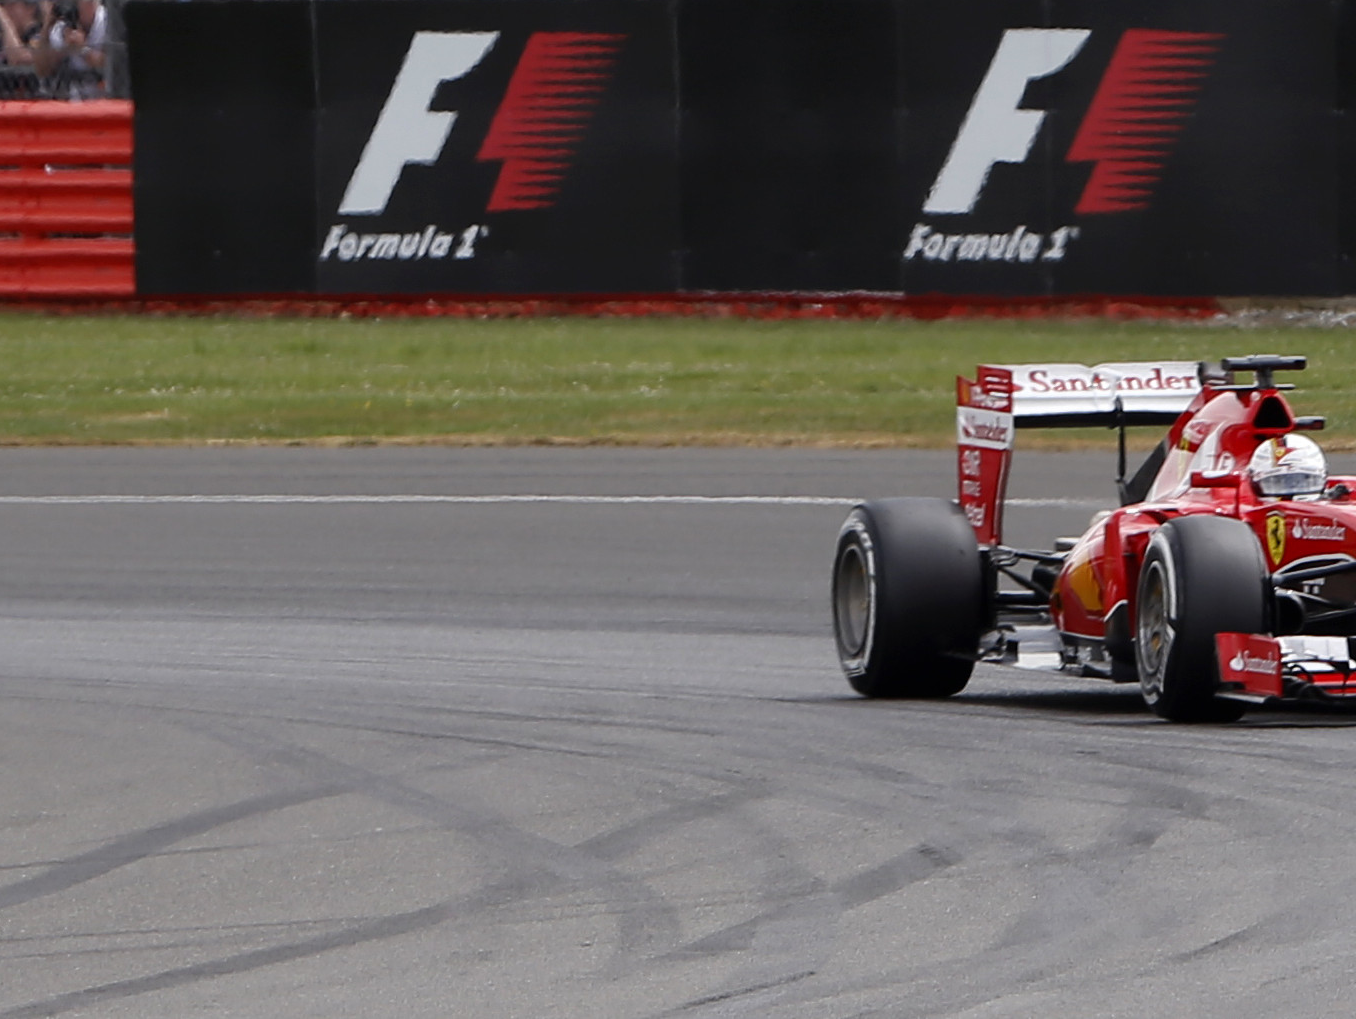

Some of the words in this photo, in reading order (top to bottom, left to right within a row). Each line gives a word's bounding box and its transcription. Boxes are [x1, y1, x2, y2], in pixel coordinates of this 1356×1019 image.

[319, 224, 454, 261] Formula
[903, 222, 1044, 261] Formula
[1029, 368, 1194, 393] Santnder
